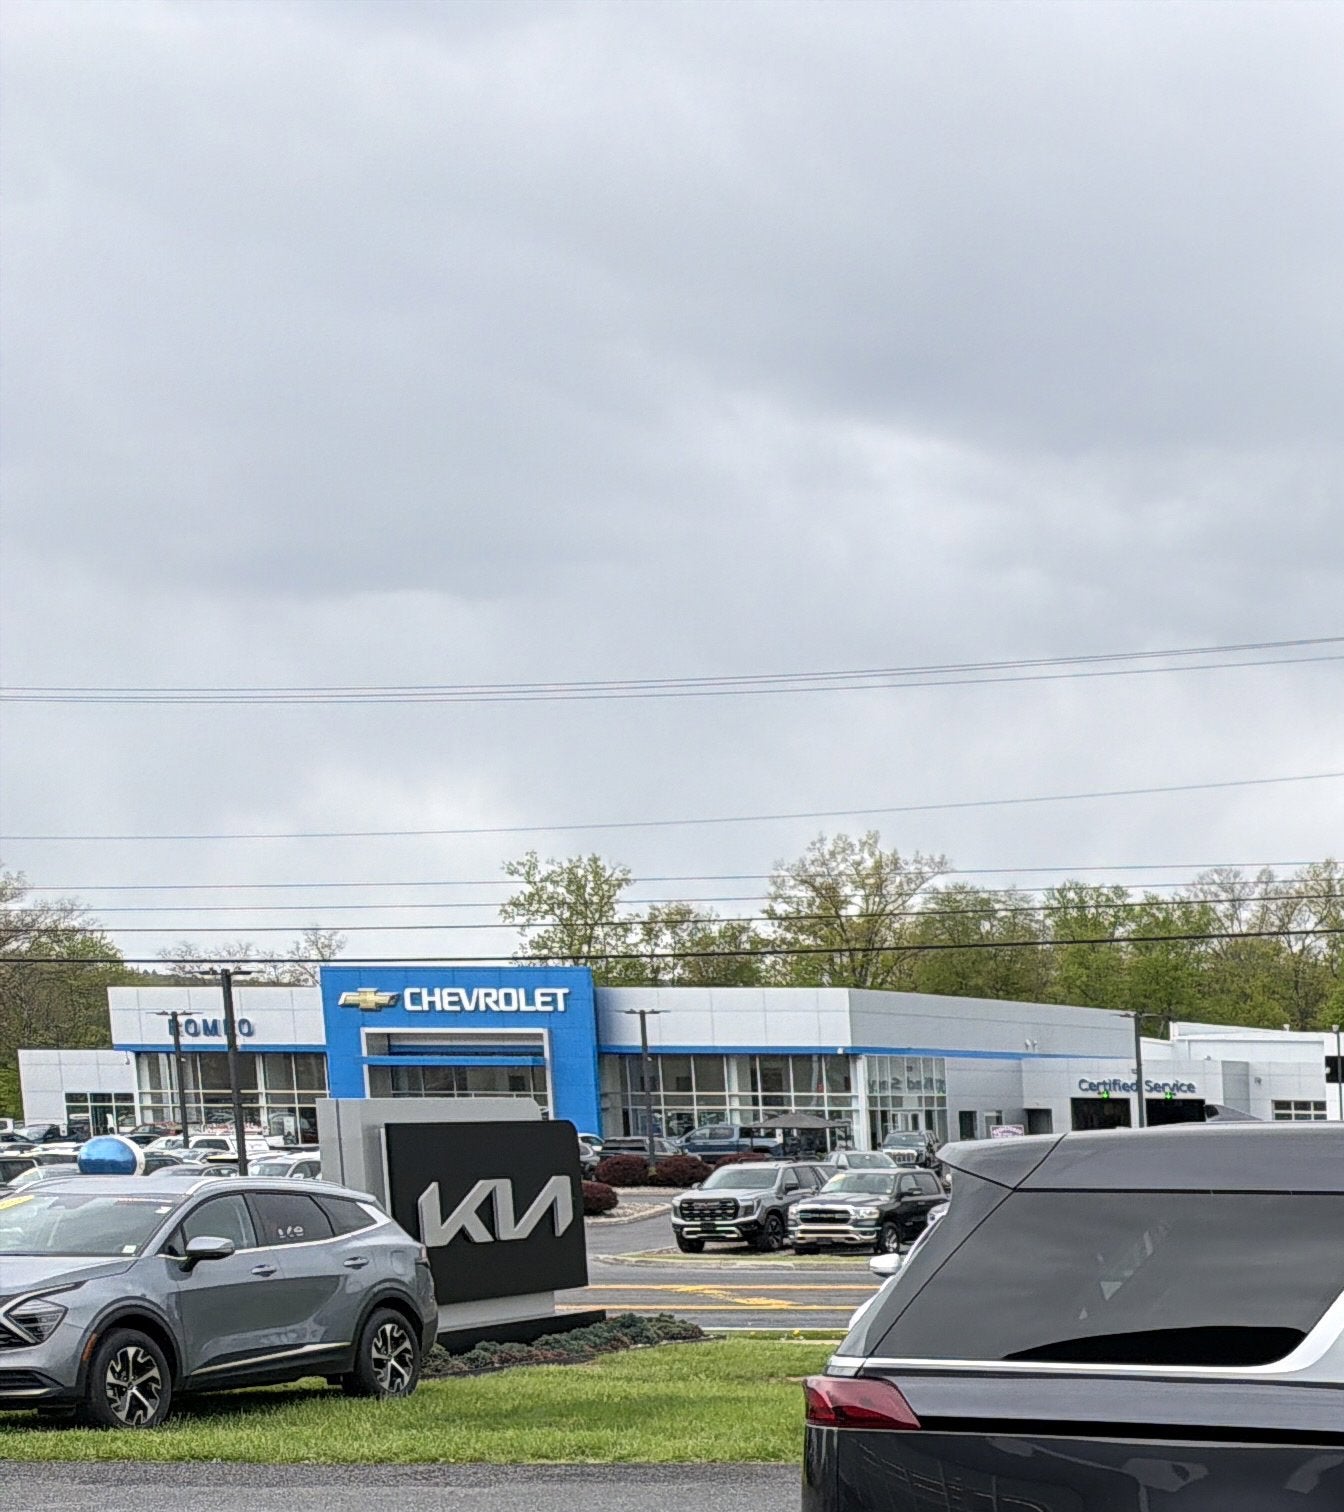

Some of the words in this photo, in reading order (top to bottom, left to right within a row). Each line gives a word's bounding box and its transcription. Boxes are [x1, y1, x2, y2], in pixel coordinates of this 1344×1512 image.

[402, 987, 571, 1013] CHEVROLET
[1078, 1079, 1139, 1093] Certified
[1144, 1080, 1196, 1093] Service
[417, 1175, 574, 1248] KIA
